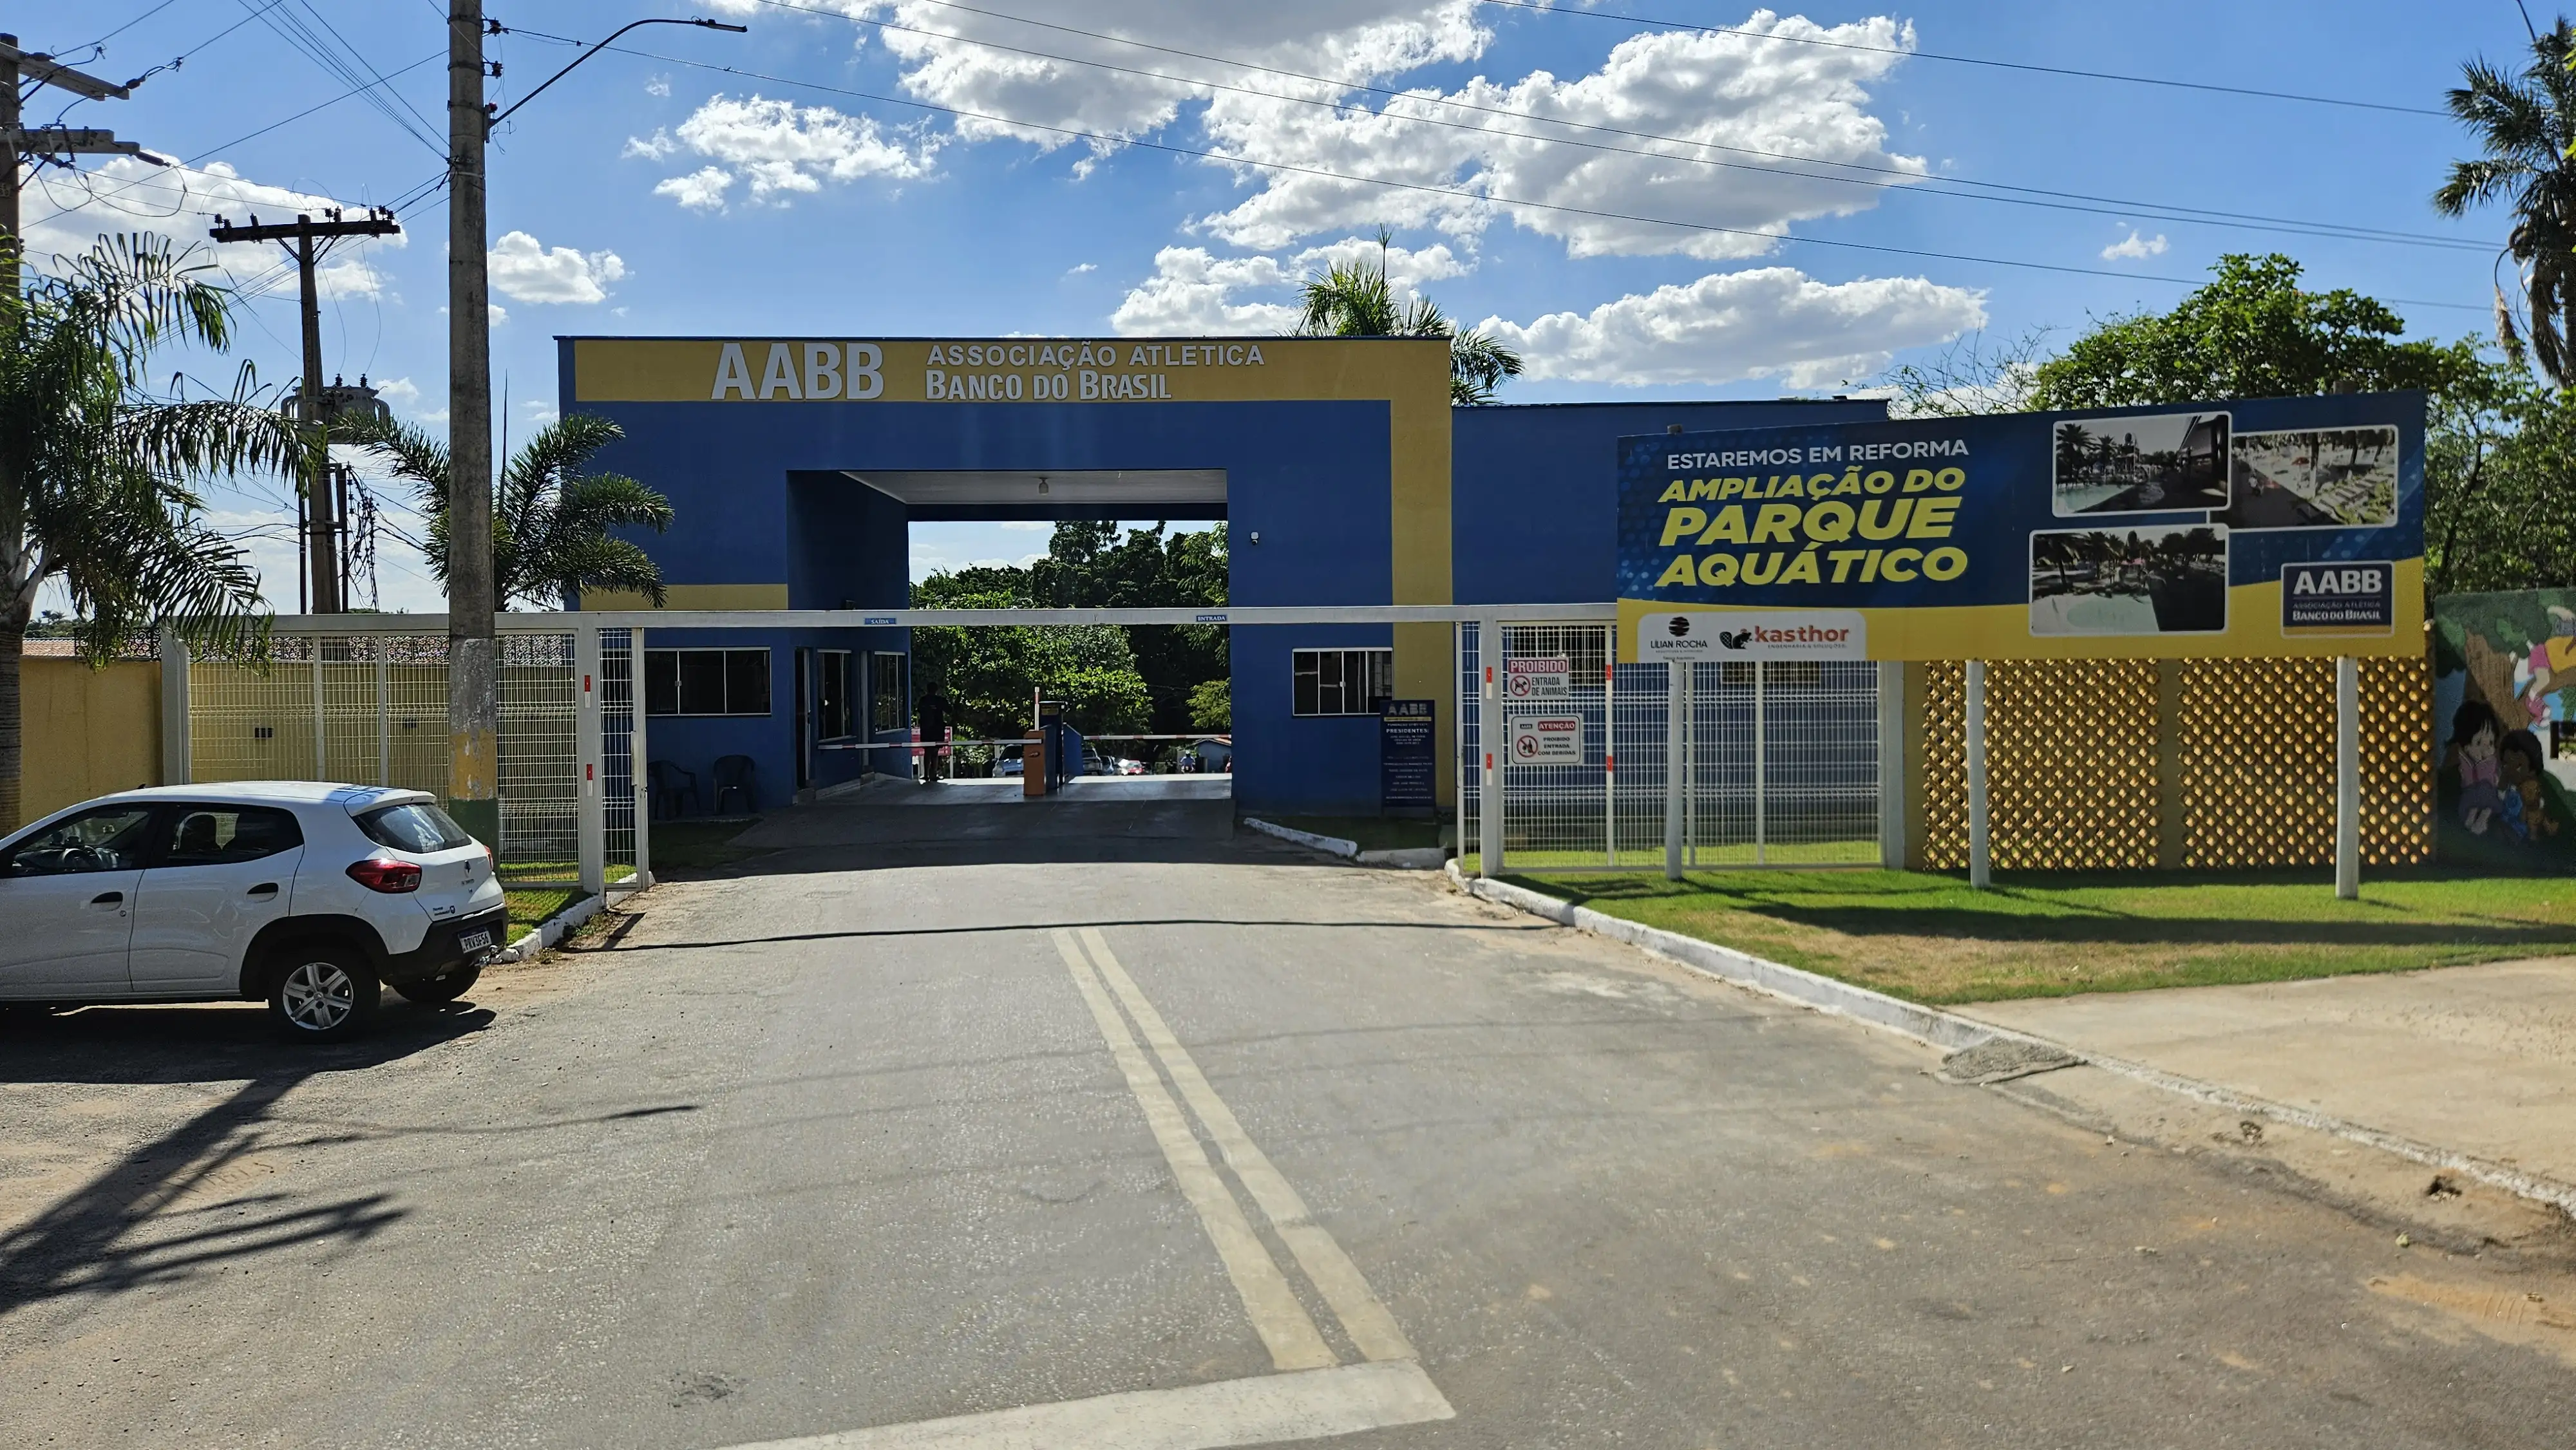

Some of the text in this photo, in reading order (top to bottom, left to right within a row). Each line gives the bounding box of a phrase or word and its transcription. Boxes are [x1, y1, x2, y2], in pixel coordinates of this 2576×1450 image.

[926, 341, 1265, 371] ASSOCIAÇÃO ATLETICA
[710, 342, 884, 400] AABB
[925, 370, 1172, 400] BANCO DO BRASIL
[1667, 440, 1969, 469] ESTAREMOS EM REFORMA
[1657, 466, 1965, 502] AMPLIAÇÃO DO
[1659, 496, 1963, 547] PARQUE
[1654, 541, 1968, 587] AQUÁTICO
[2293, 569, 2382, 594] AABB
[2293, 600, 2342, 609] ASSOCIAÇÃO
[2293, 610, 2381, 621] BANCO DO BRASIL
[1676, 640, 1708, 648] ROCHA
[1754, 625, 1850, 643] kasthor
[1510, 661, 1566, 673] PROIBIDO
[1531, 677, 1560, 686] ENTRADA
[1531, 686, 1567, 696] DE ANIMAIS
[1387, 703, 1427, 715] AABB
